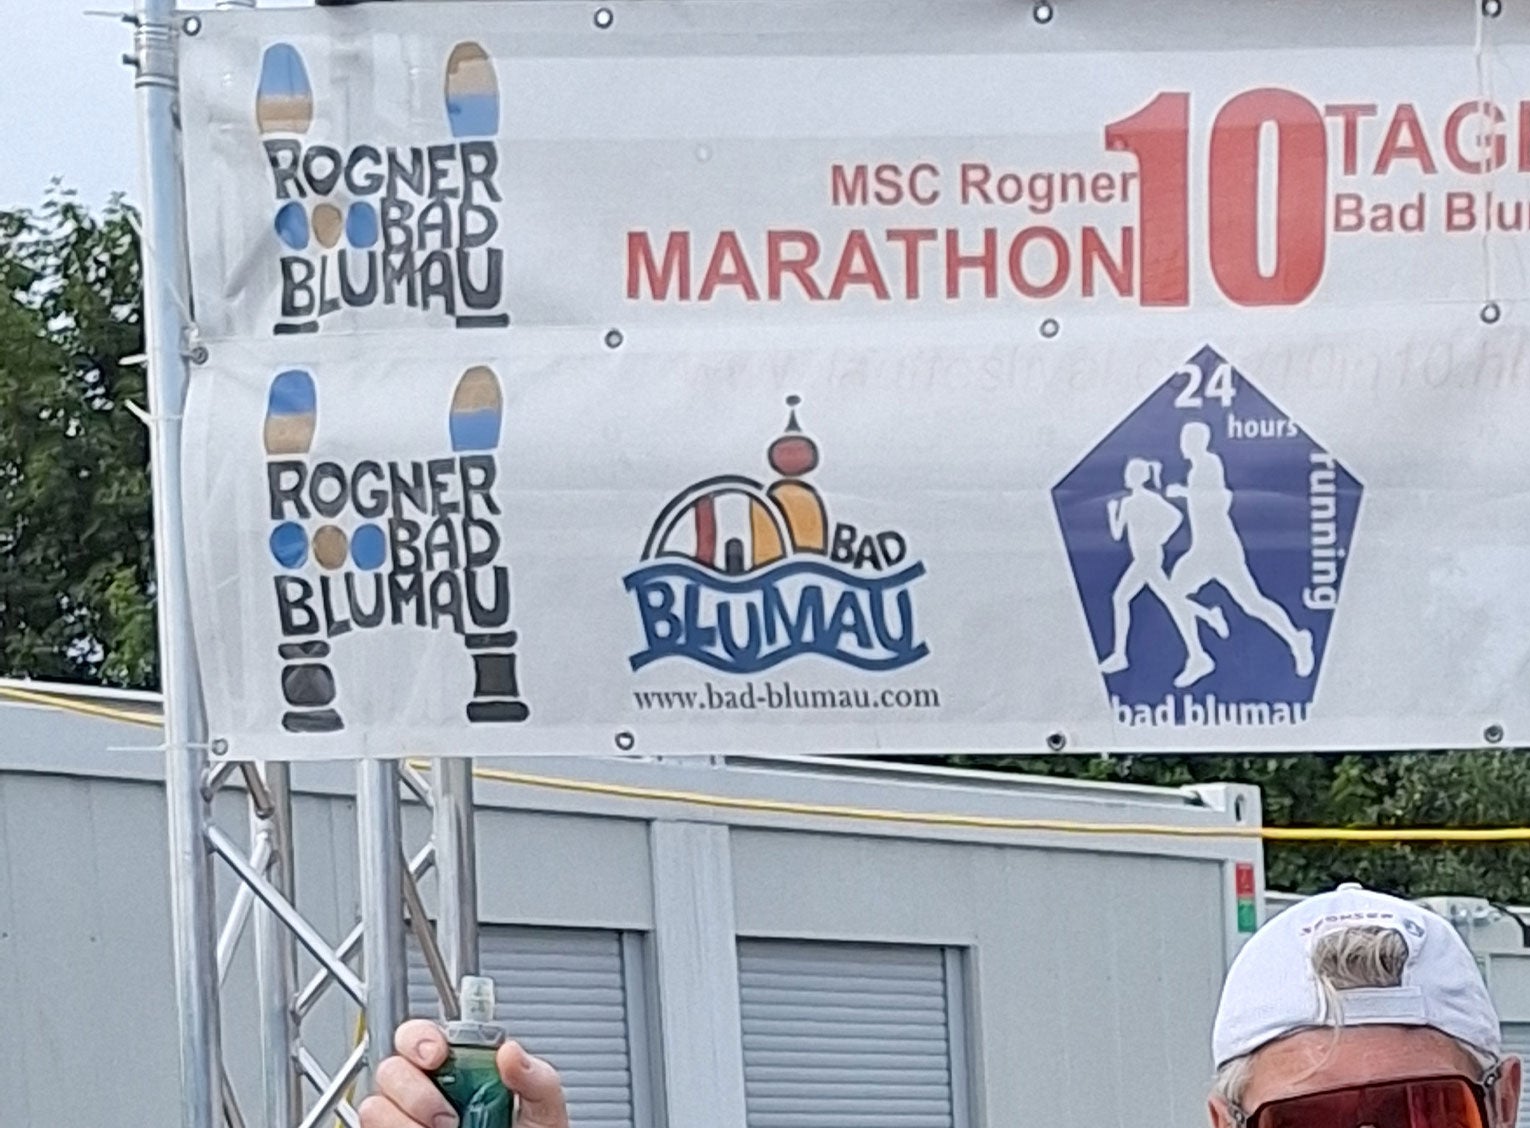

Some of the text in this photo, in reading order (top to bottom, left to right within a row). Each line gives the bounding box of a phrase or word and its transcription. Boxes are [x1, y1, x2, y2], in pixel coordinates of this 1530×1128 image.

[262, 139, 502, 202] ROGNER
[831, 162, 1138, 214] MSC Rogner
[1105, 87, 1328, 308] 10
[380, 200, 498, 253] BAD
[1334, 192, 1425, 233] Bad
[280, 247, 502, 317] BLUMAU
[626, 226, 1135, 301] MARATHON
[1175, 363, 1237, 409] 24
[1227, 414, 1298, 439] hours
[267, 455, 501, 520] ROGNER
[389, 517, 500, 573] BAD
[831, 521, 907, 572] BAD
[1302, 449, 1346, 610] running
[275, 565, 509, 636] BLUMAU
[636, 578, 920, 662] BLUMAU
[633, 681, 941, 711] www.bad-blumau.com
[1111, 694, 1312, 727] bad blumau
